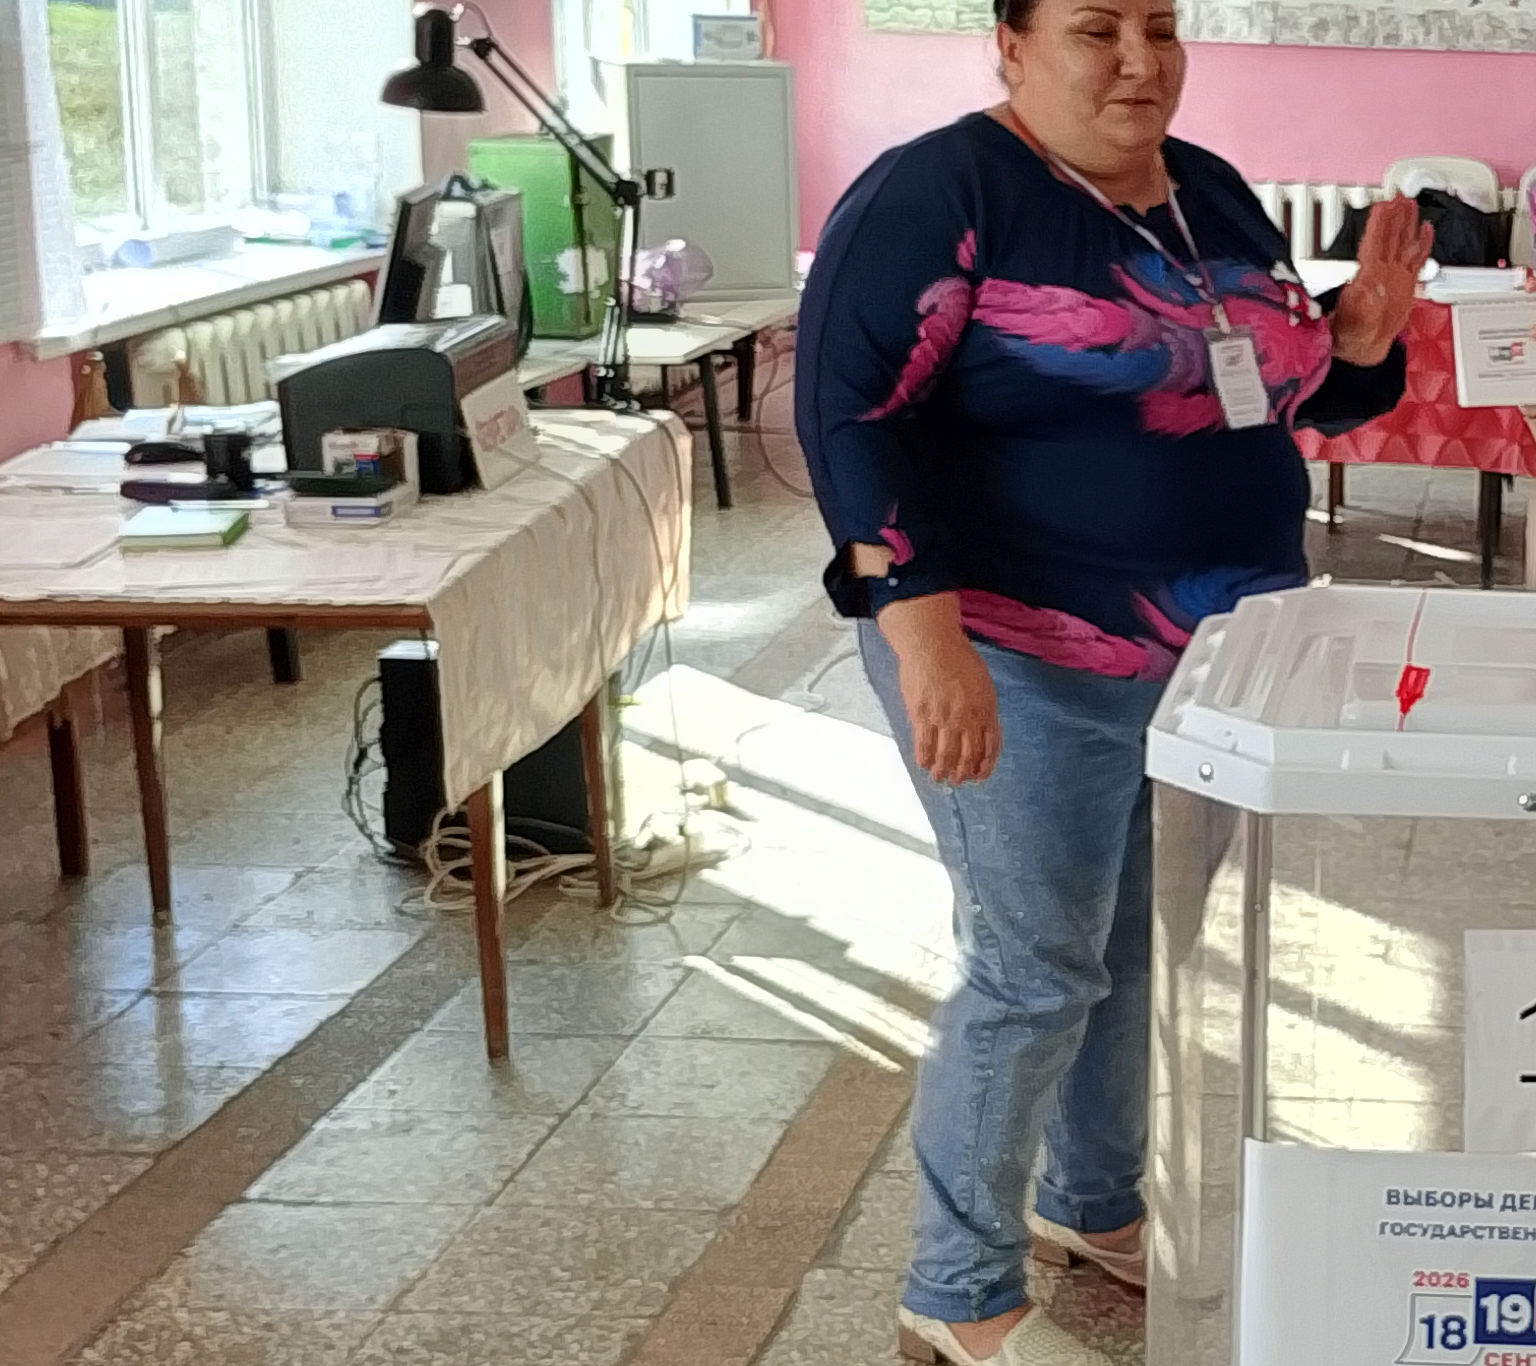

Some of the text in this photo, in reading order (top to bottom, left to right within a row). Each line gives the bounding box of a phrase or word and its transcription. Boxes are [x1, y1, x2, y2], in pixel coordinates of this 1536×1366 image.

[1386, 1188, 1494, 1209] ВЫБОРЫ
[1412, 1270, 1470, 1289] 2026
[1419, 1314, 1468, 1351] 18
[1480, 1293, 1533, 1334] 19
